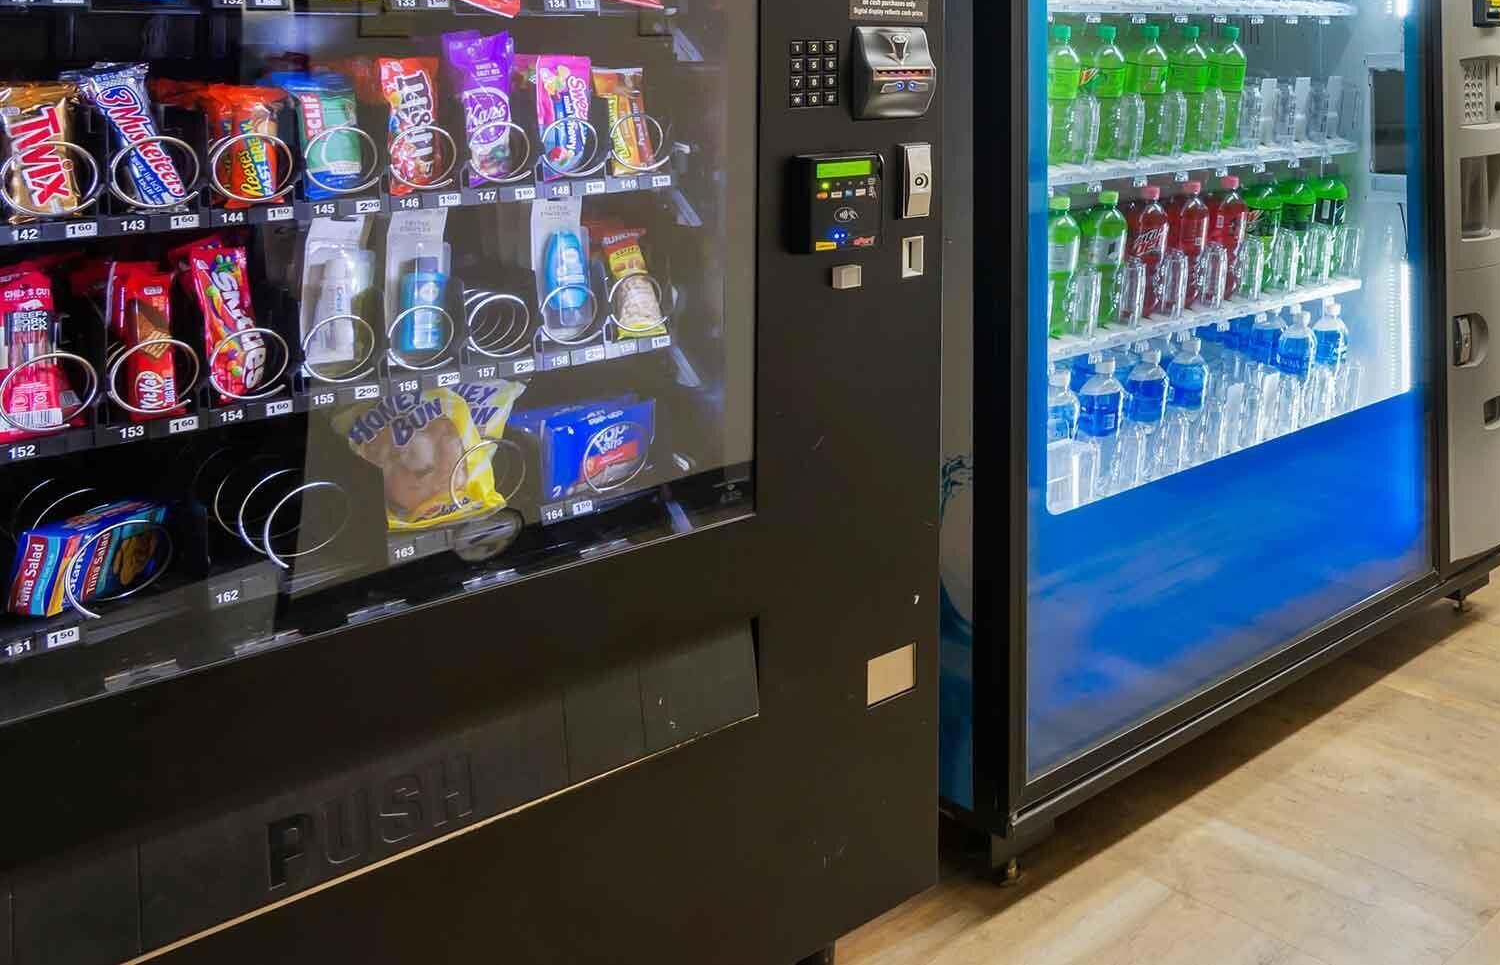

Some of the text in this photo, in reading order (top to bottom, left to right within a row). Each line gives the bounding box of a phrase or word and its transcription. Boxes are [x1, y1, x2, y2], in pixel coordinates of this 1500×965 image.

[548, 0, 566, 9] 134
[301, 92, 321, 127] CLIF
[478, 191, 497, 201] 147
[551, 186, 569, 196] 148
[313, 204, 335, 214] 145
[400, 198, 419, 208] 146
[221, 212, 244, 223] 144
[121, 220, 145, 231] 143
[11, 228, 38, 240] 142
[551, 355, 568, 366] 158
[478, 366, 495, 378] 157
[399, 381, 418, 391] 156
[312, 392, 334, 404] 155
[219, 409, 243, 422] 154
[393, 398, 443, 446] BUN
[120, 426, 145, 438] 153
[9, 445, 36, 459] 152
[545, 509, 563, 521] 164
[394, 546, 415, 559] 163
[86, 532, 111, 594] Tuna Salad
[15, 580, 35, 607] Tuna
[25, 543, 45, 577] Salad
[215, 590, 239, 604] 162
[5, 640, 32, 656] 161
[266, 753, 474, 891] PUSH
